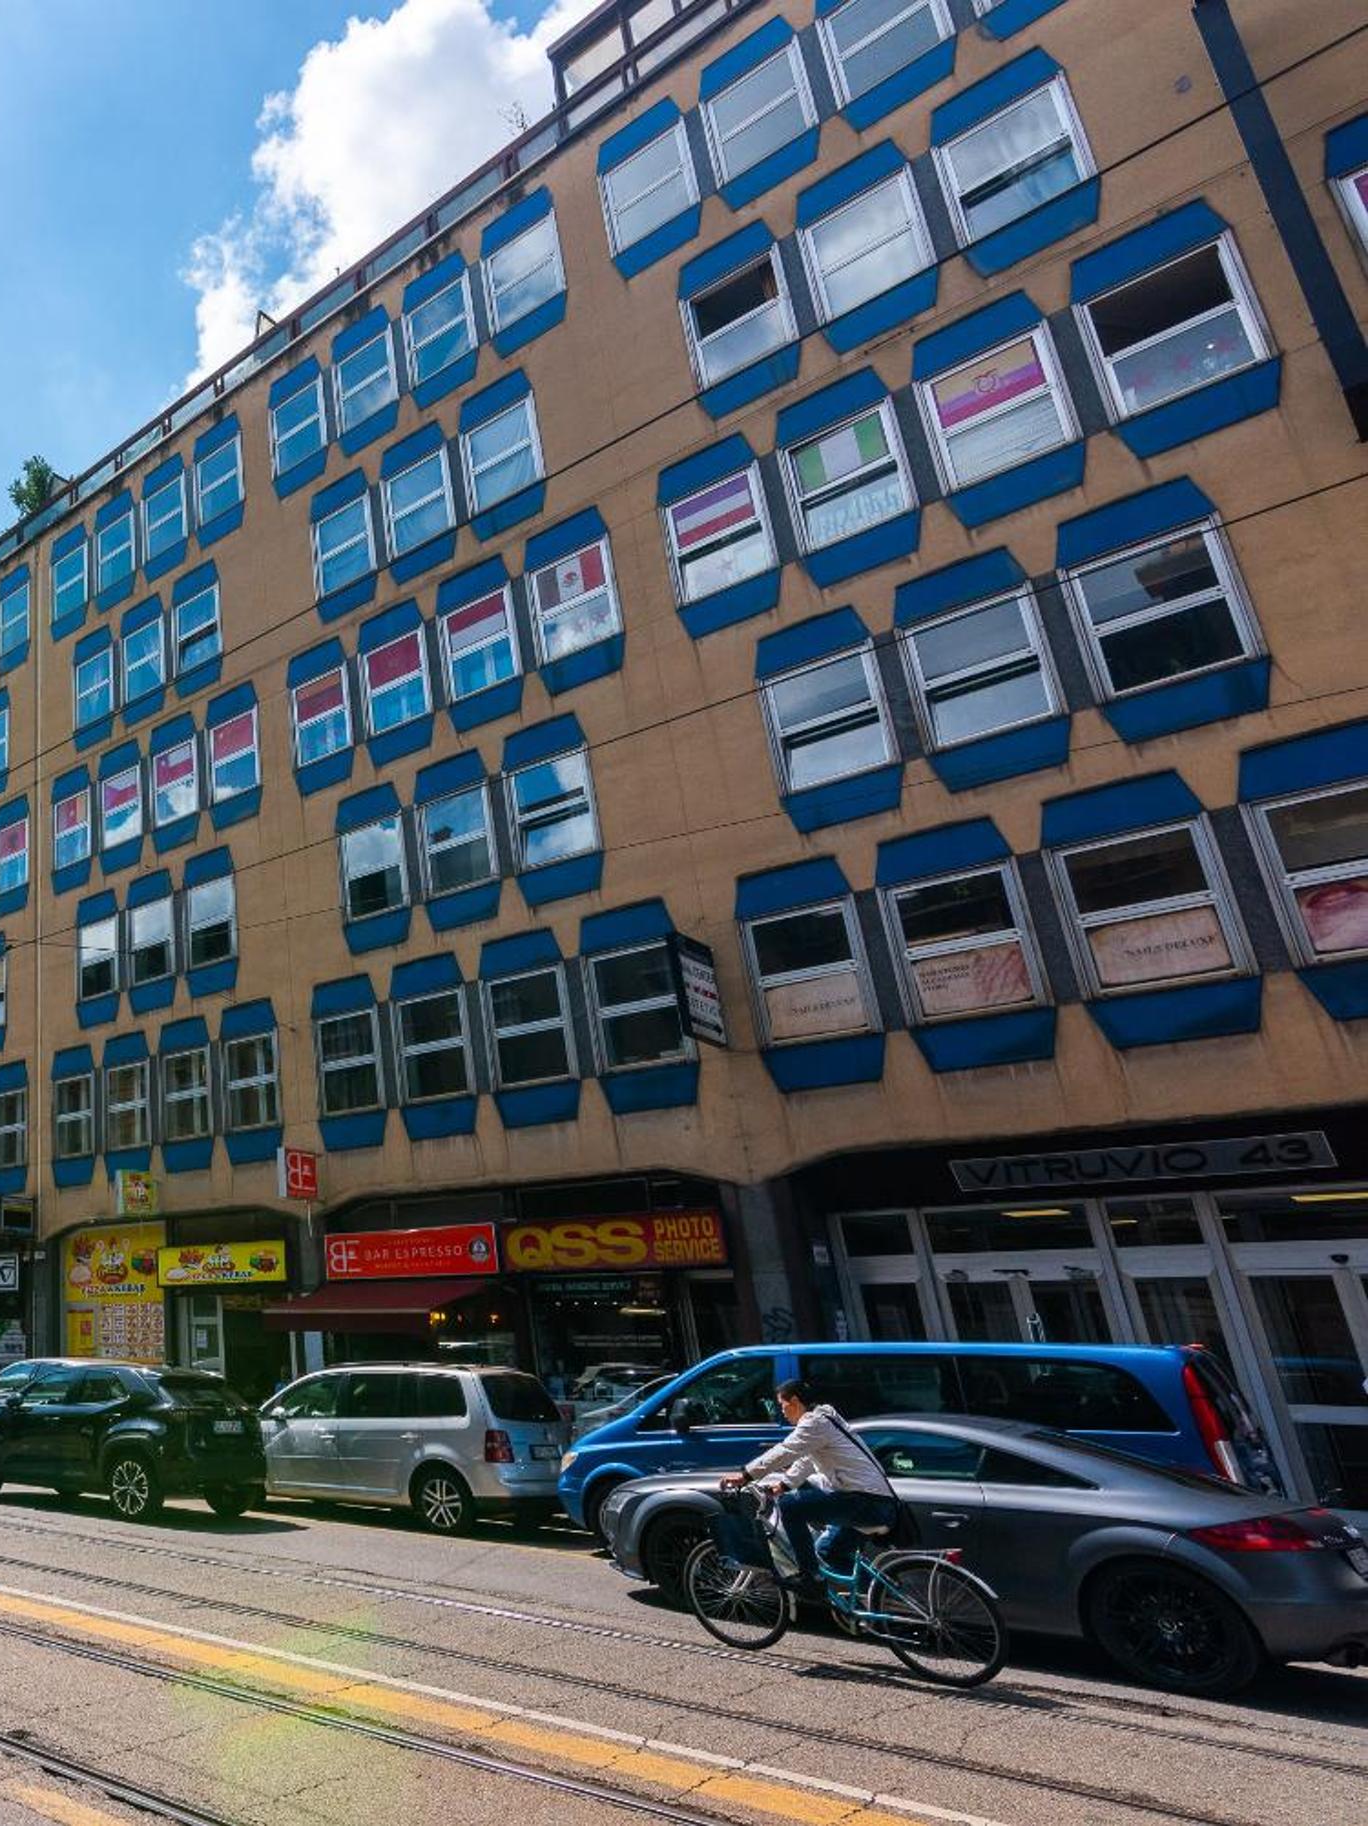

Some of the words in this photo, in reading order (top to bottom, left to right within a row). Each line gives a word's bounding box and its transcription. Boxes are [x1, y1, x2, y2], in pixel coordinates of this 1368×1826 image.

[965, 1147, 1206, 1185] VITRUVIO
[1239, 1138, 1313, 1166] 43
[653, 1216, 714, 1239] PHOTO
[364, 1247, 390, 1261] BAR
[394, 1244, 463, 1260] ESPRESSO
[506, 1220, 648, 1268] QSS
[653, 1238, 721, 1262] SERVICE
